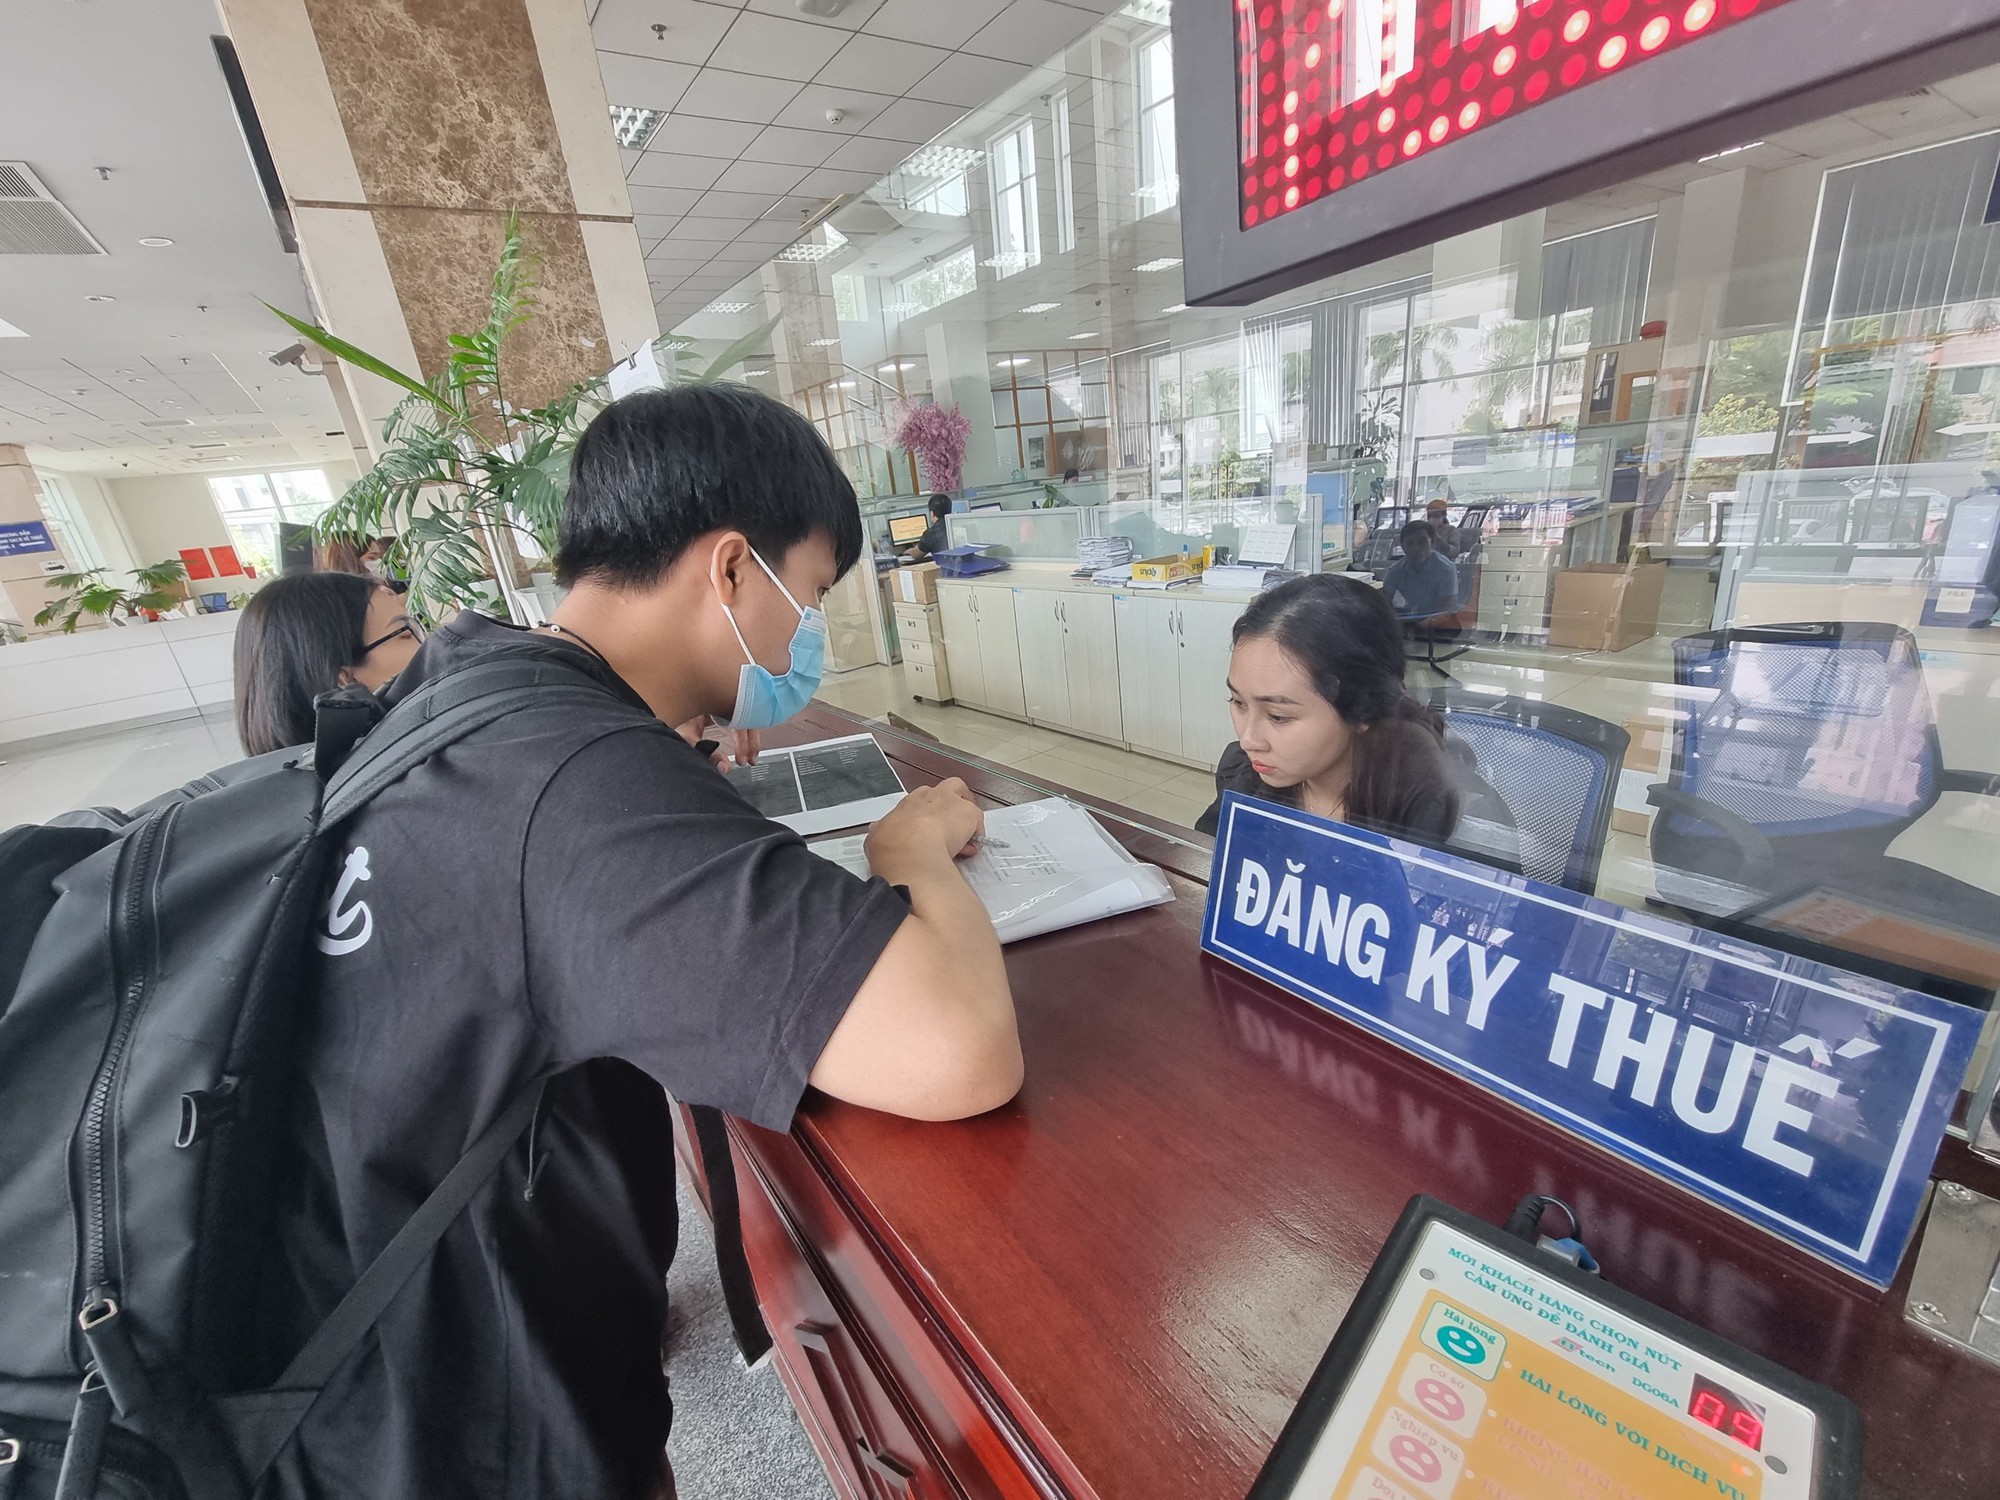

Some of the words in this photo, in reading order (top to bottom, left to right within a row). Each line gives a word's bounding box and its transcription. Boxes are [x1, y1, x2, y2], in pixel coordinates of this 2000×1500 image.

[1232, 858, 1390, 985] ĐĂNG
[1405, 923, 1520, 1031] KÝ
[1547, 973, 1883, 1178] THUẾ
